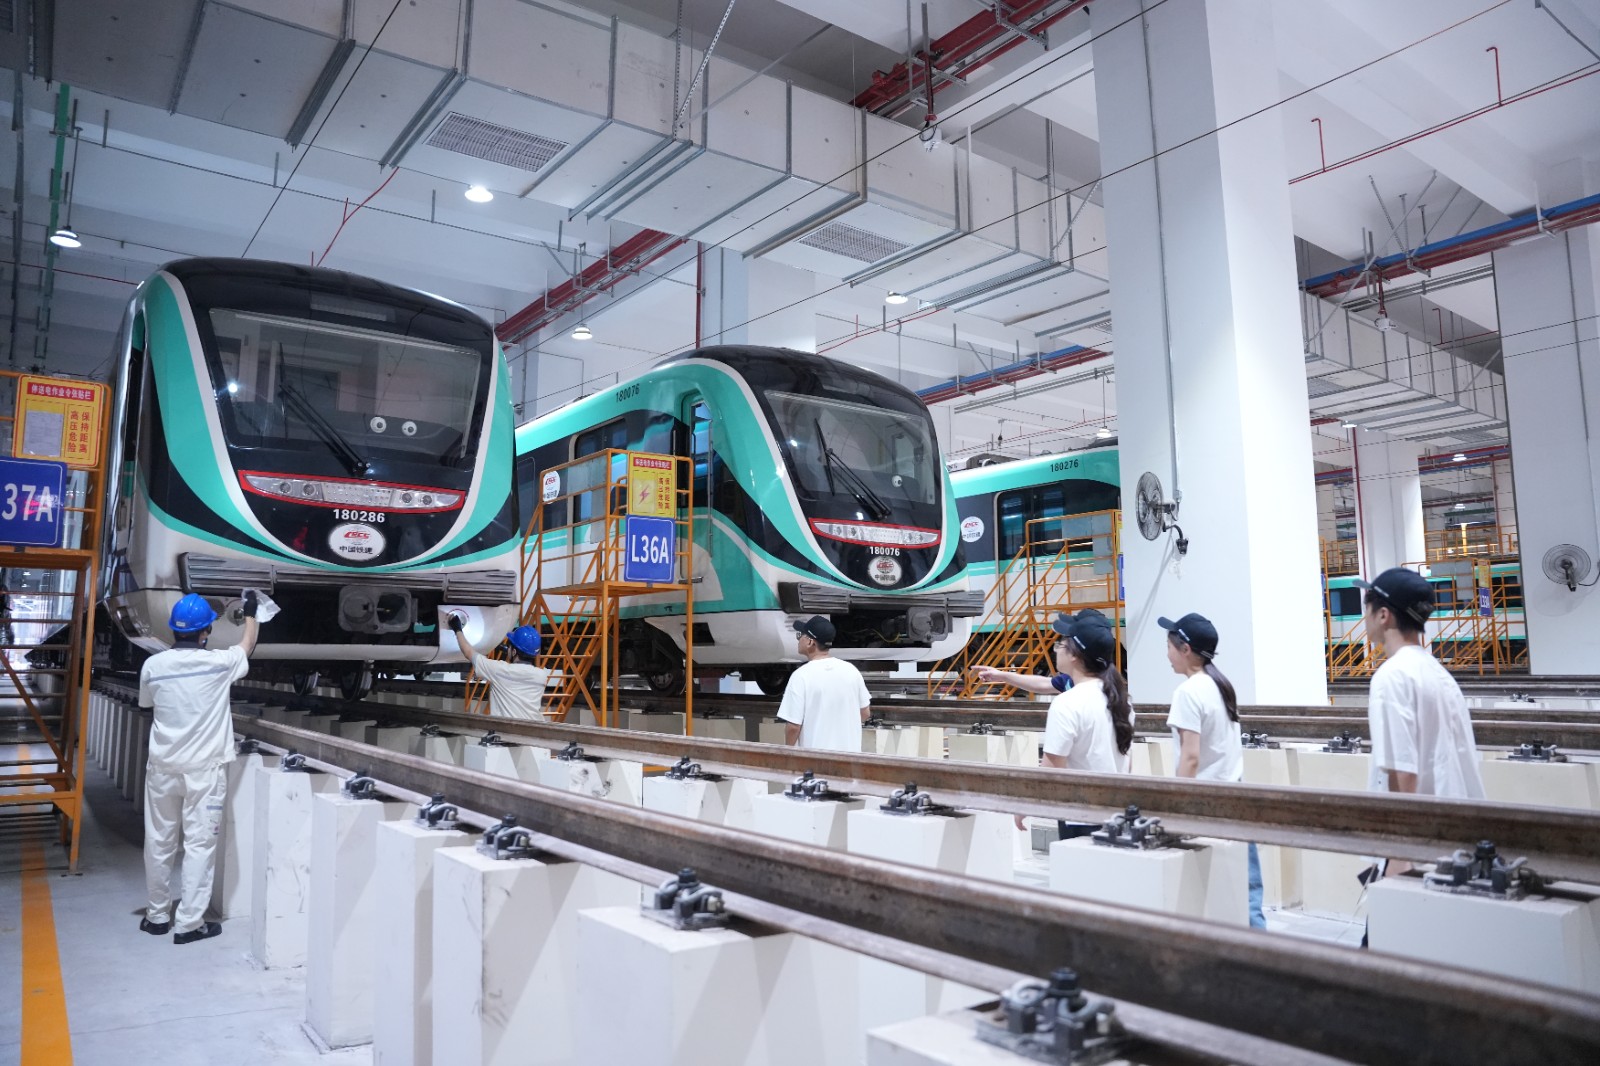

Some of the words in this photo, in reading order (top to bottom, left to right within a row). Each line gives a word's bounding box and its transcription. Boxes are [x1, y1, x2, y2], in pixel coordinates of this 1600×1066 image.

[616, 383, 640, 403] 180076
[67, 410, 79, 453] 高压危险
[79, 411, 91, 454] 保持距离
[1050, 459, 1079, 473] 180276
[333, 509, 385, 523] 180286
[631, 534, 670, 565] L36A
[869, 546, 901, 557] 180076
